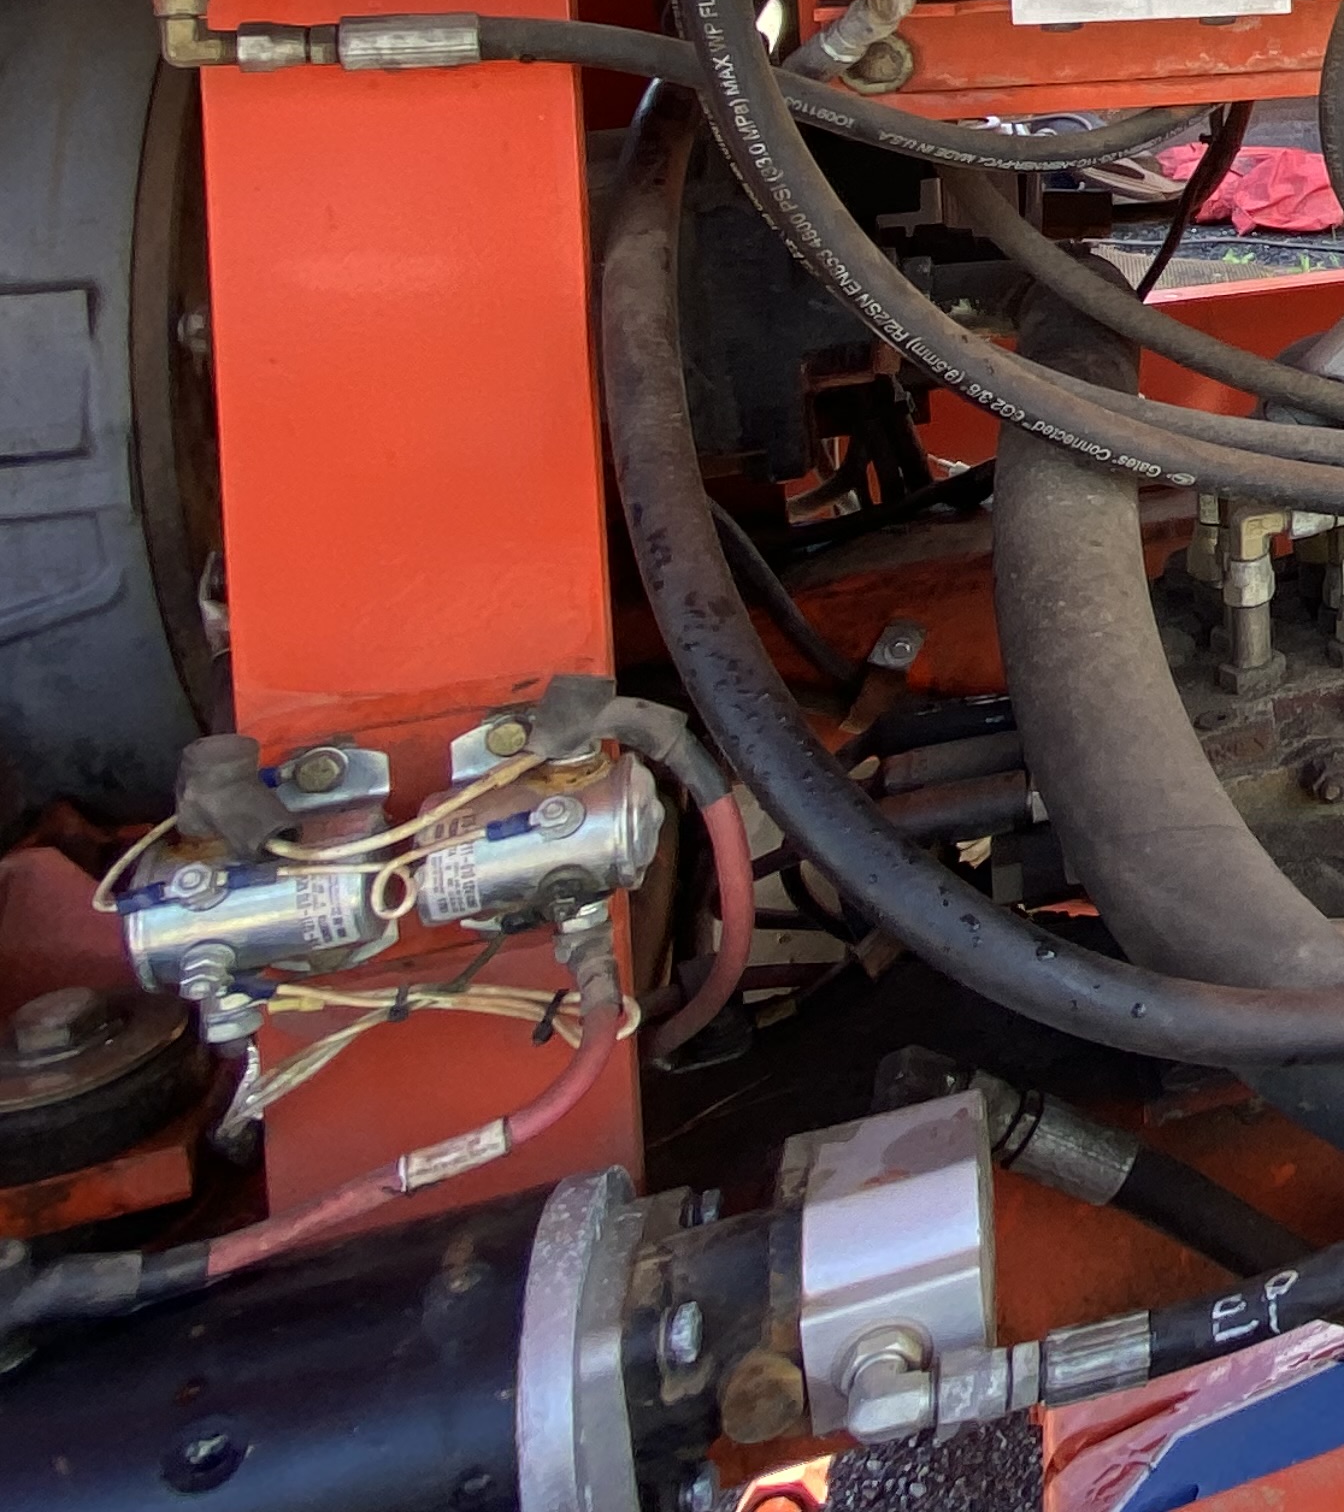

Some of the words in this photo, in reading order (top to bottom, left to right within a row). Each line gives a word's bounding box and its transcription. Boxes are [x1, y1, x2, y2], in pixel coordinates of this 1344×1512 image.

[703, 22, 726, 55] WP
[712, 54, 741, 98] MAX
[770, 182, 798, 213] PSI
